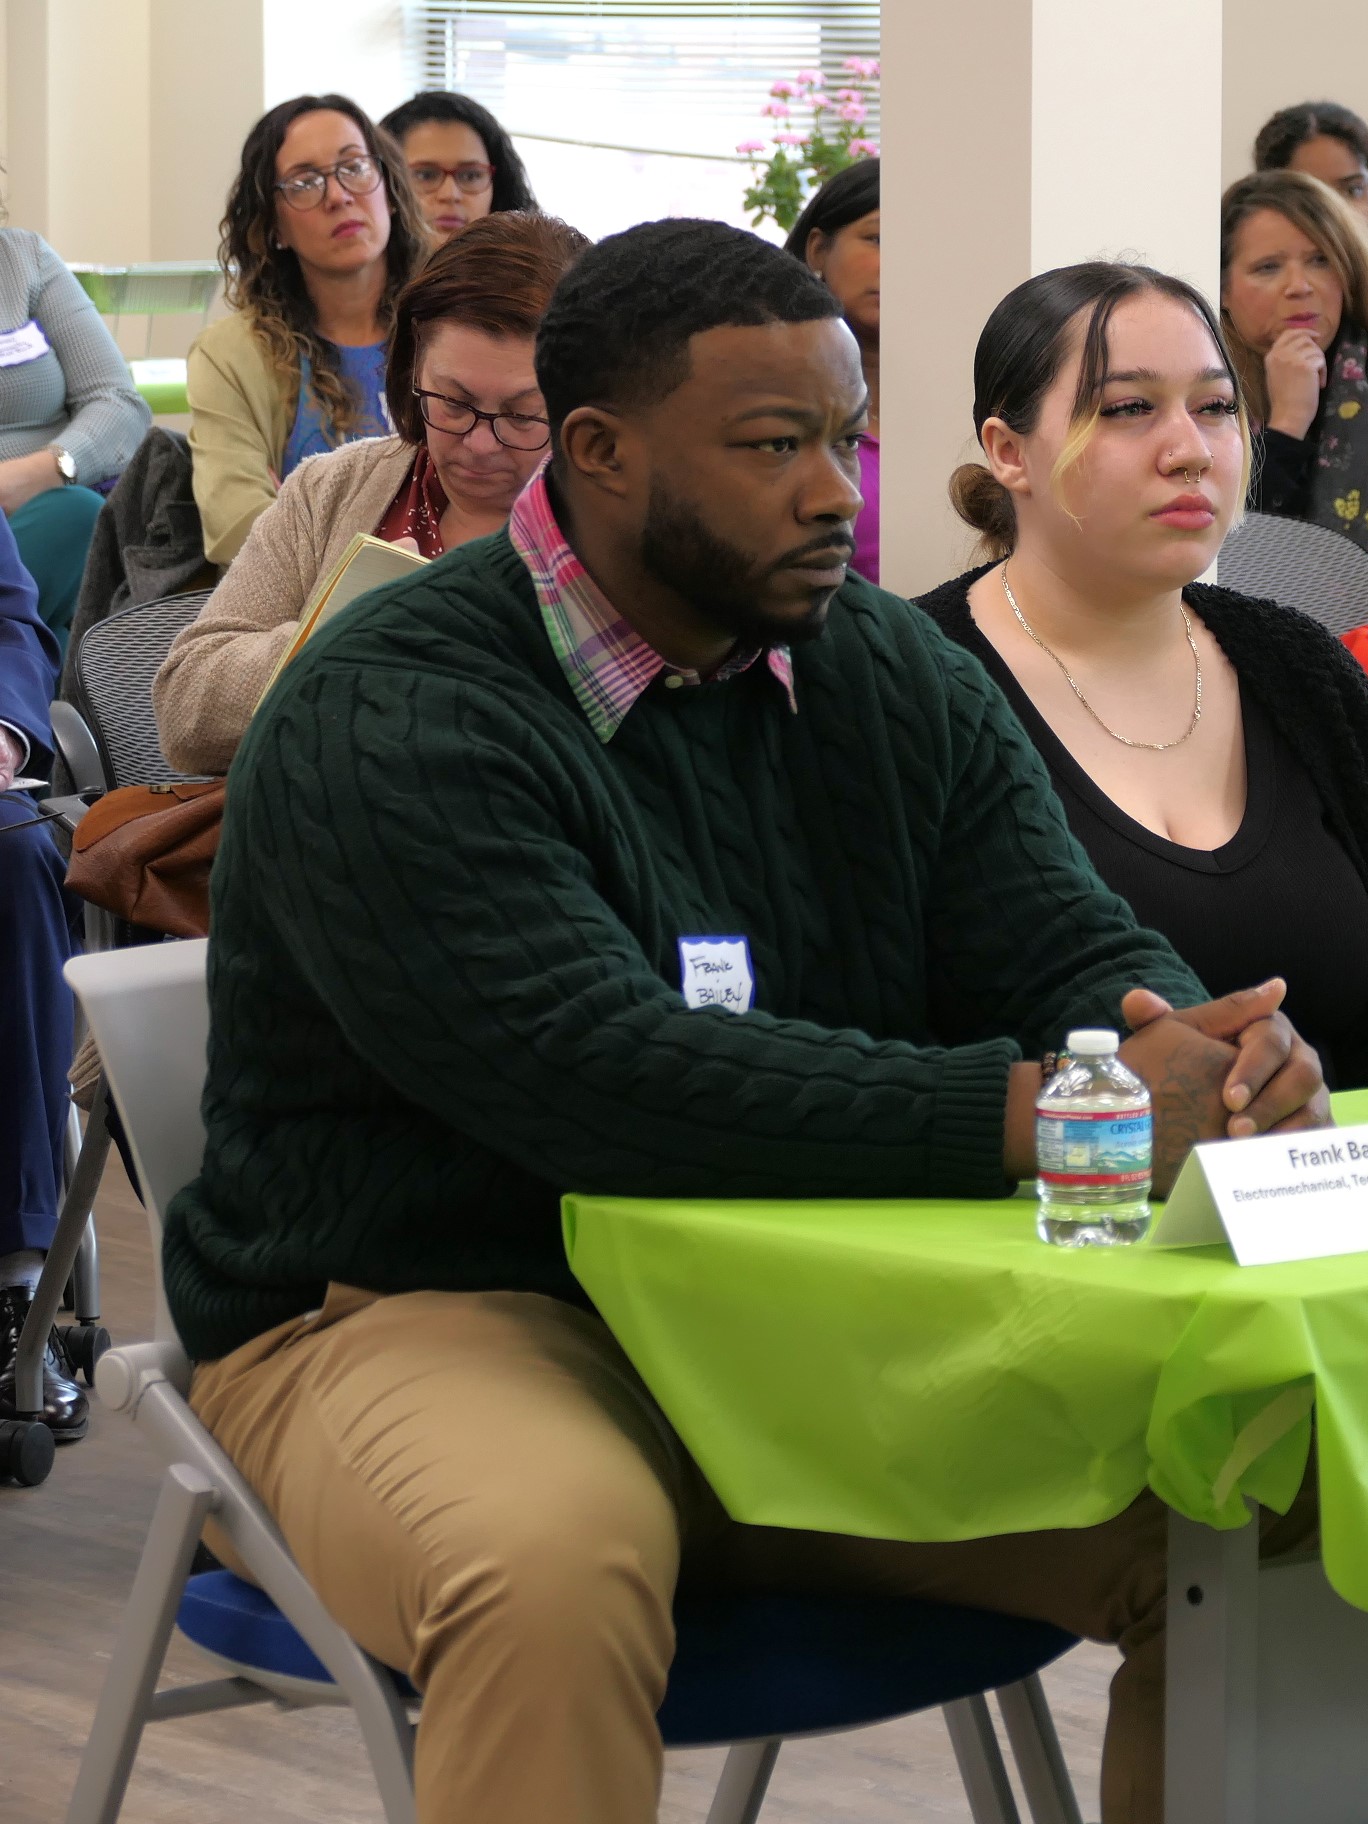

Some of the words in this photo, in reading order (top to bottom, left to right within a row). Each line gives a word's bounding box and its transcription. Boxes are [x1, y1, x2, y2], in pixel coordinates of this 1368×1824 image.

[1110, 1121, 1144, 1135] CRYSTAL
[1287, 1144, 1344, 1169] Frank
[1232, 1176, 1350, 1203] Electromechanical,
